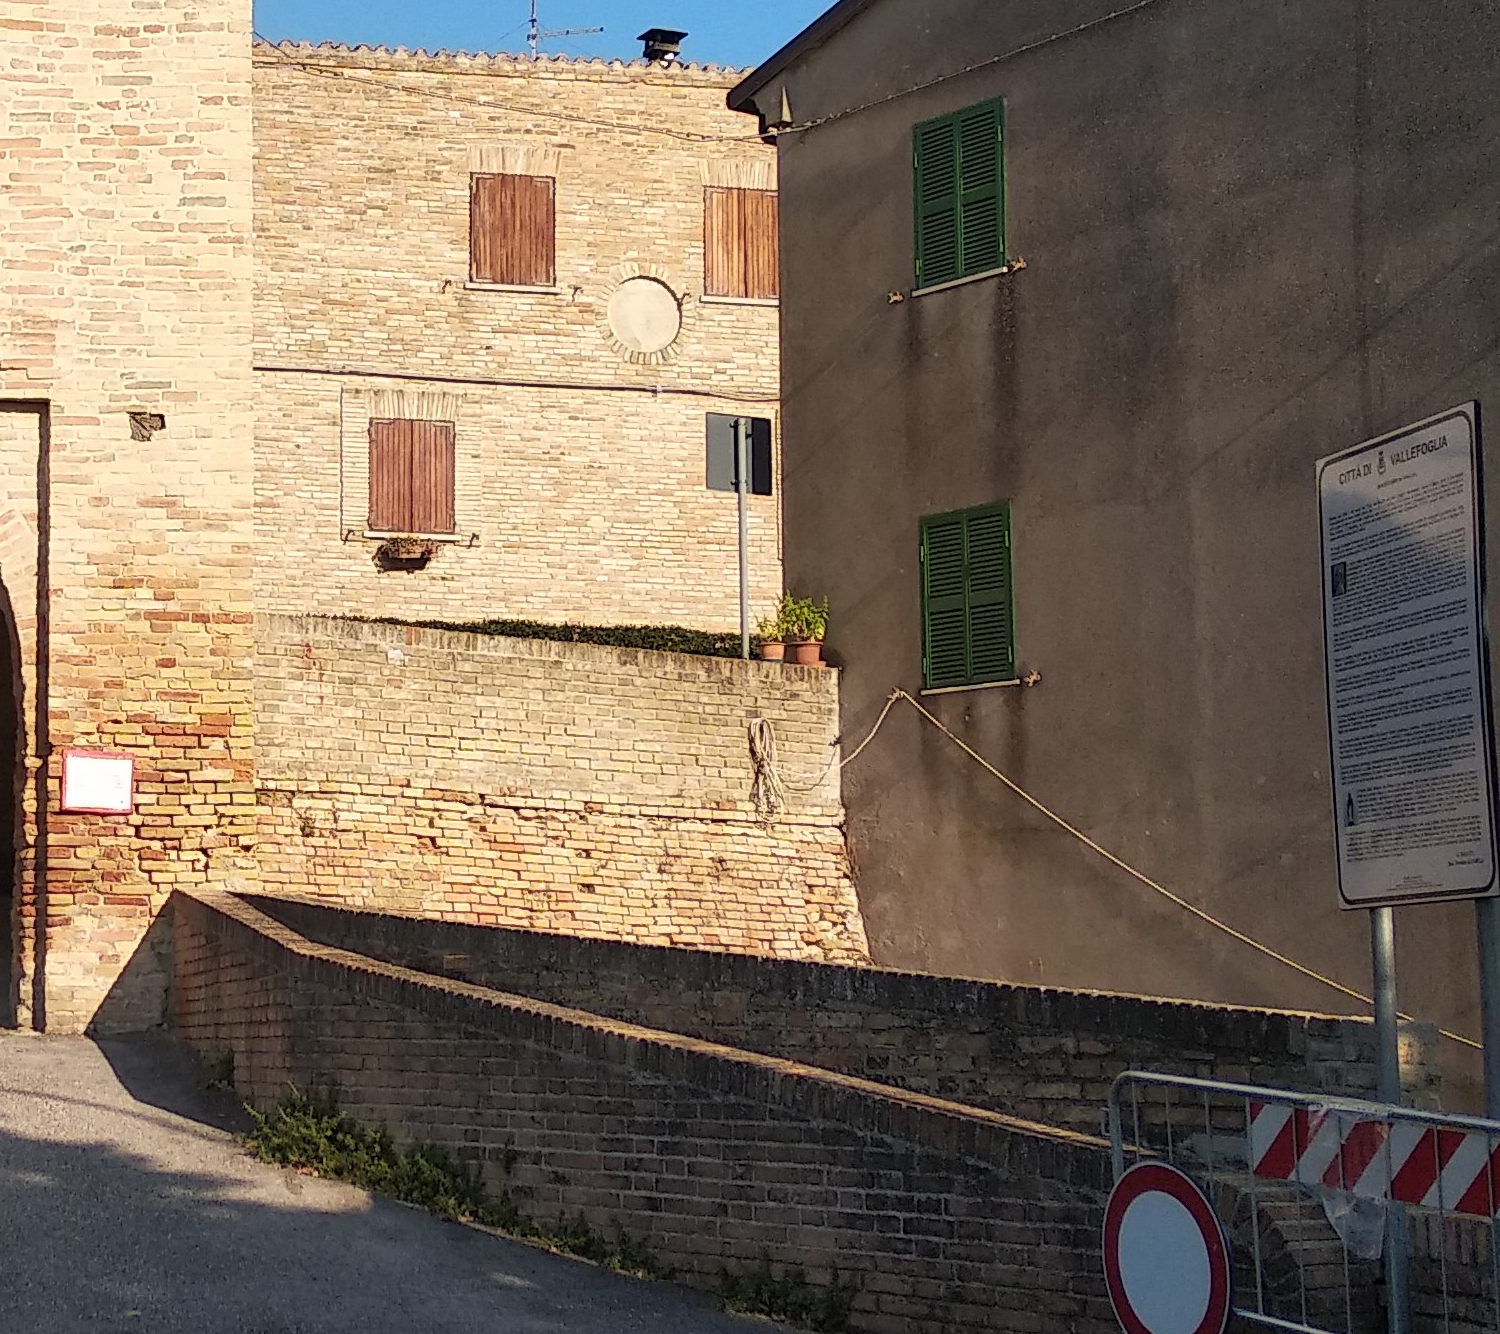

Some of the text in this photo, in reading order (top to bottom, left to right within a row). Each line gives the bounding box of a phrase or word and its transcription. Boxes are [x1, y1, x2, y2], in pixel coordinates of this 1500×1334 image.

[1339, 463, 1362, 484] CITTÀ
[1363, 463, 1372, 477] DI
[1390, 435, 1448, 466] VALLEFOGLIA
